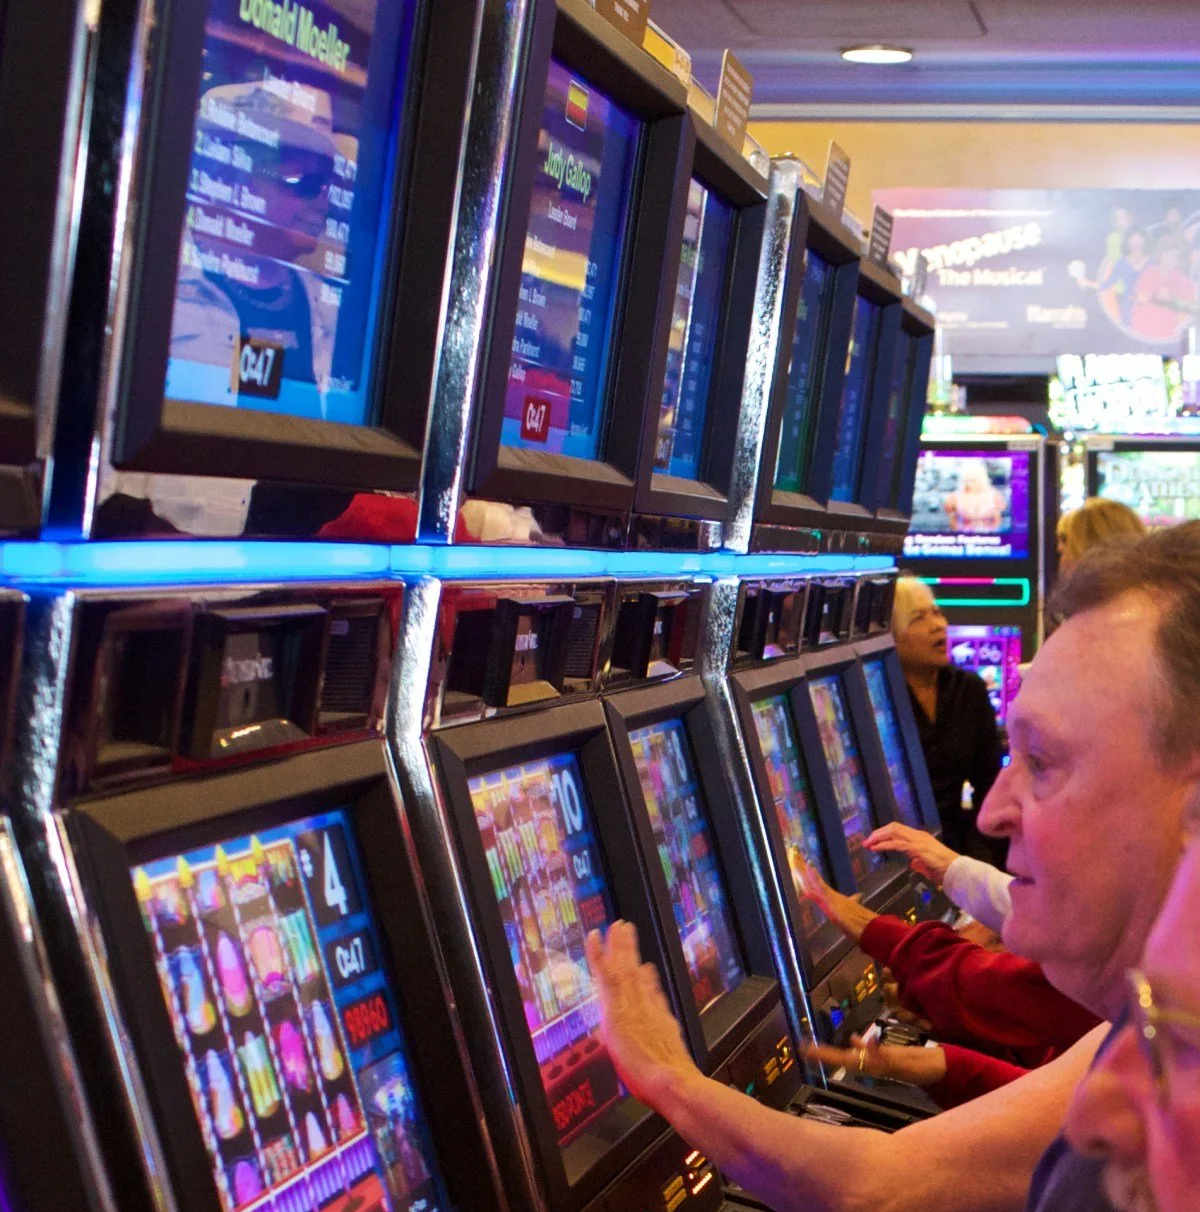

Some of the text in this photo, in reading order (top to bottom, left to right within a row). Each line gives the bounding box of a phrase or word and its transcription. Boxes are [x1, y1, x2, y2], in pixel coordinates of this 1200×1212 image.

[544, 143, 592, 203] Judy Gallop
[972, 267, 1043, 287] Musical
[239, 344, 276, 387] 0:47
[525, 402, 547, 433] 0:47
[323, 831, 348, 915] 4
[335, 937, 365, 979] 0:47
